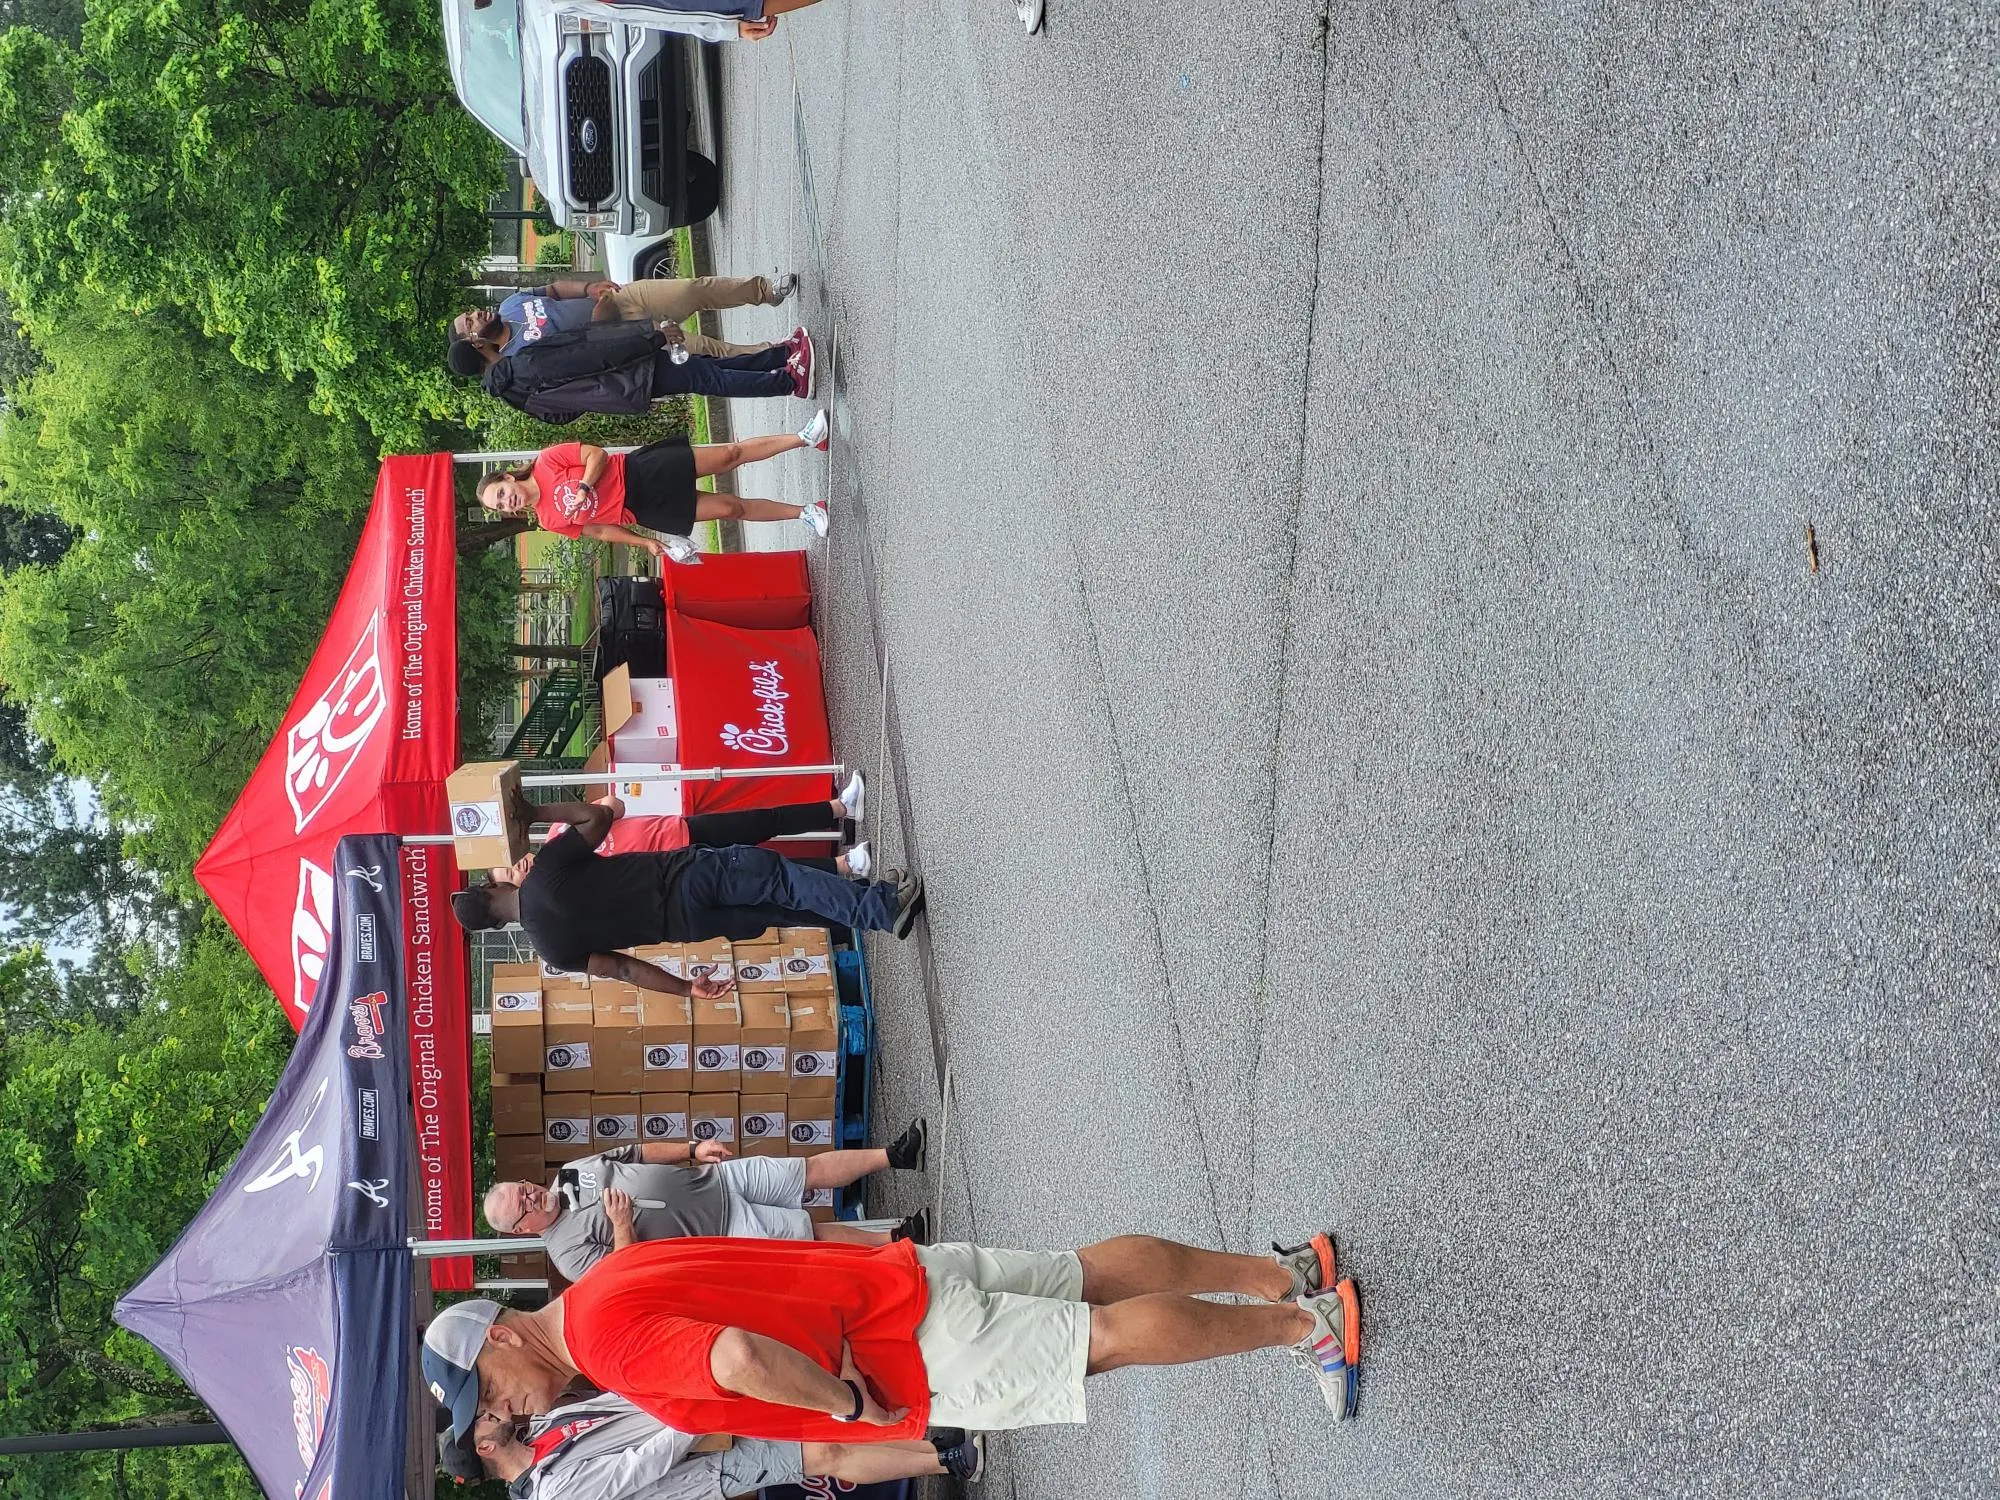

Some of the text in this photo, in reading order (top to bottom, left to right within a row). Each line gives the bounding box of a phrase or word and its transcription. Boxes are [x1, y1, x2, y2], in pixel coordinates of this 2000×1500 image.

[405, 549, 424, 597] Chicken
[403, 600, 427, 651] Original
[402, 683, 423, 696] of
[404, 655, 423, 679] The
[403, 700, 422, 740] Home
[736, 660, 789, 756] Chick-fil-A
[360, 916, 373, 960] BRAVES.COM
[412, 952, 433, 1028] Chicken
[347, 1004, 385, 1059] Braves
[416, 1033, 442, 1109] Original
[362, 1091, 376, 1138] BRAVES.COM
[420, 1115, 440, 1149] The
[422, 1155, 441, 1173] of
[425, 1178, 442, 1230] Home
